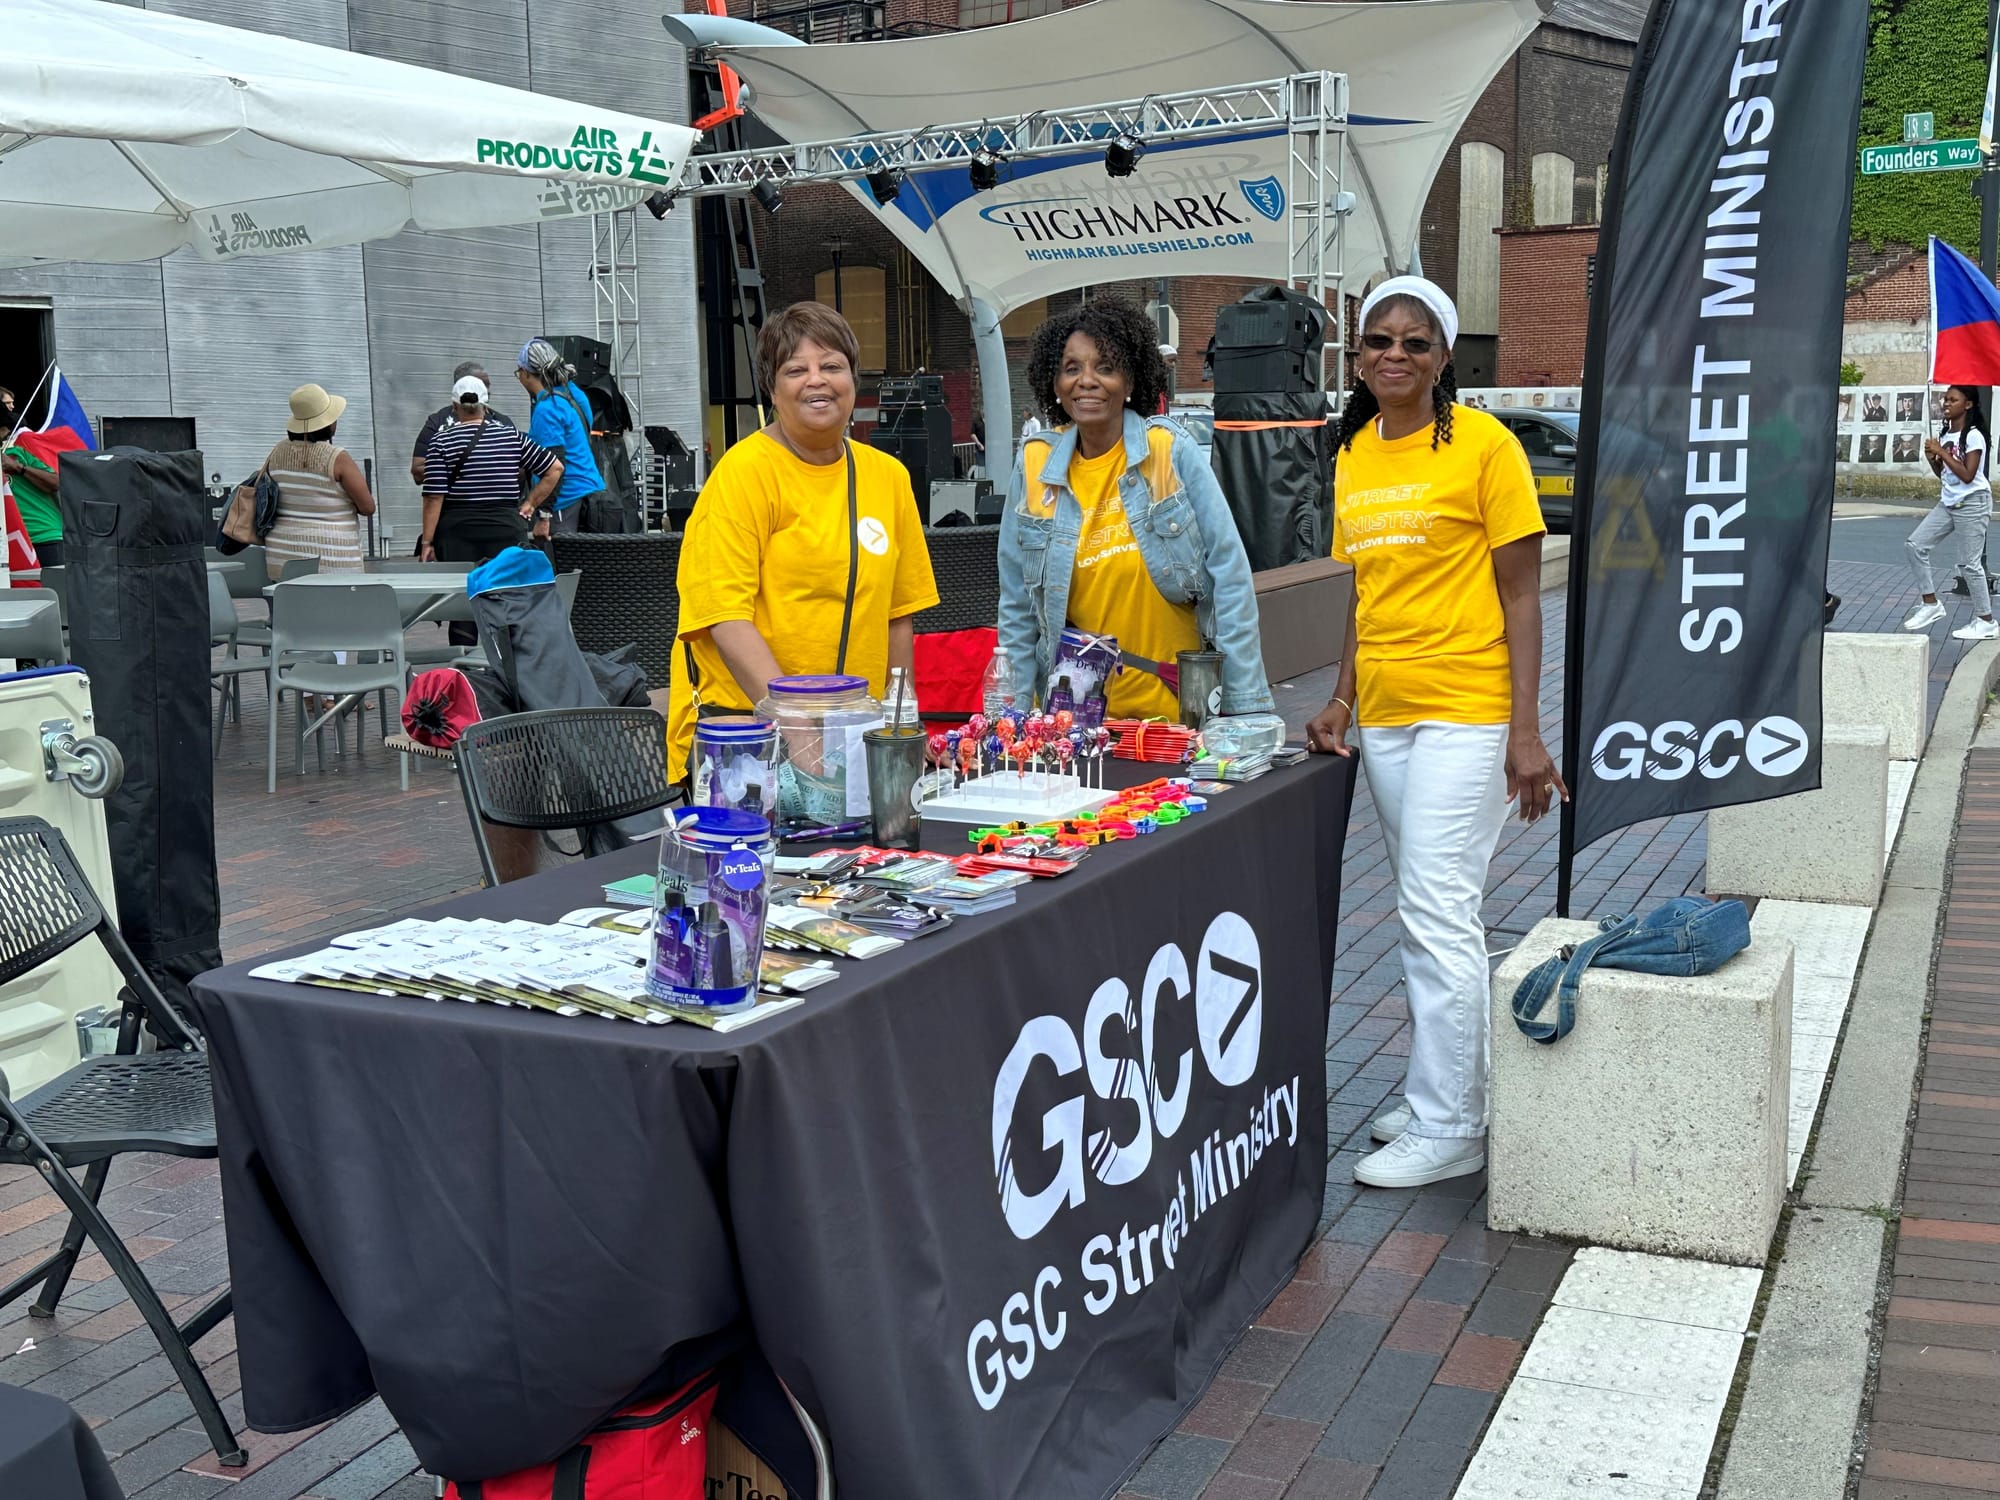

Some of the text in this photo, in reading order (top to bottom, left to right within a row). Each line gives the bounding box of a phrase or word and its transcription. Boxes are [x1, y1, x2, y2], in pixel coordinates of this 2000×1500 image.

[571, 125, 619, 150] AIR
[477, 138, 622, 176] PRODUCTS
[1866, 147, 1976, 171] Founders Way
[1003, 191, 1243, 242] HIGHMARK
[1025, 232, 1254, 261] HIGHMARKBLUESHIELD.COM
[1679, 345, 1751, 655] STREET
[1360, 537, 1383, 550] LOVE
[1385, 535, 1426, 545] SERVE
[725, 865, 737, 875] Dr
[967, 1265, 1067, 1411] GSC
[1190, 1075, 1299, 1221] Ministry
